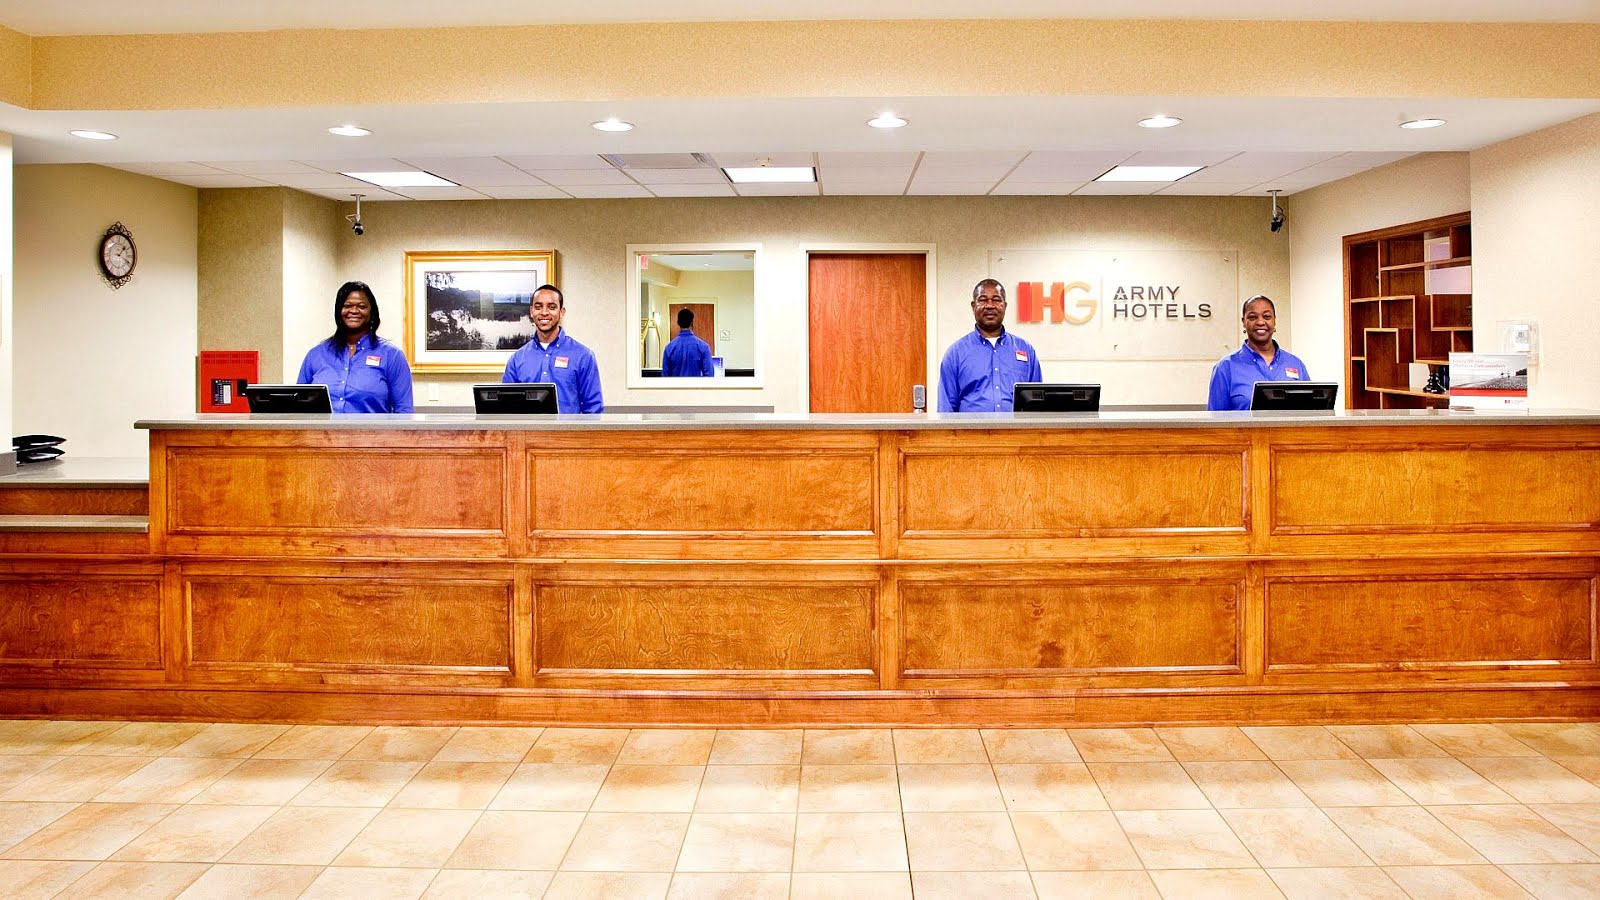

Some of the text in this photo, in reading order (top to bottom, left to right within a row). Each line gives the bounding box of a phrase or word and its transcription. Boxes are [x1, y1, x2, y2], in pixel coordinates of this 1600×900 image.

[1113, 285, 1180, 301] ARMY
[1017, 281, 1098, 324] IHG
[1113, 303, 1212, 318] HOTELS
